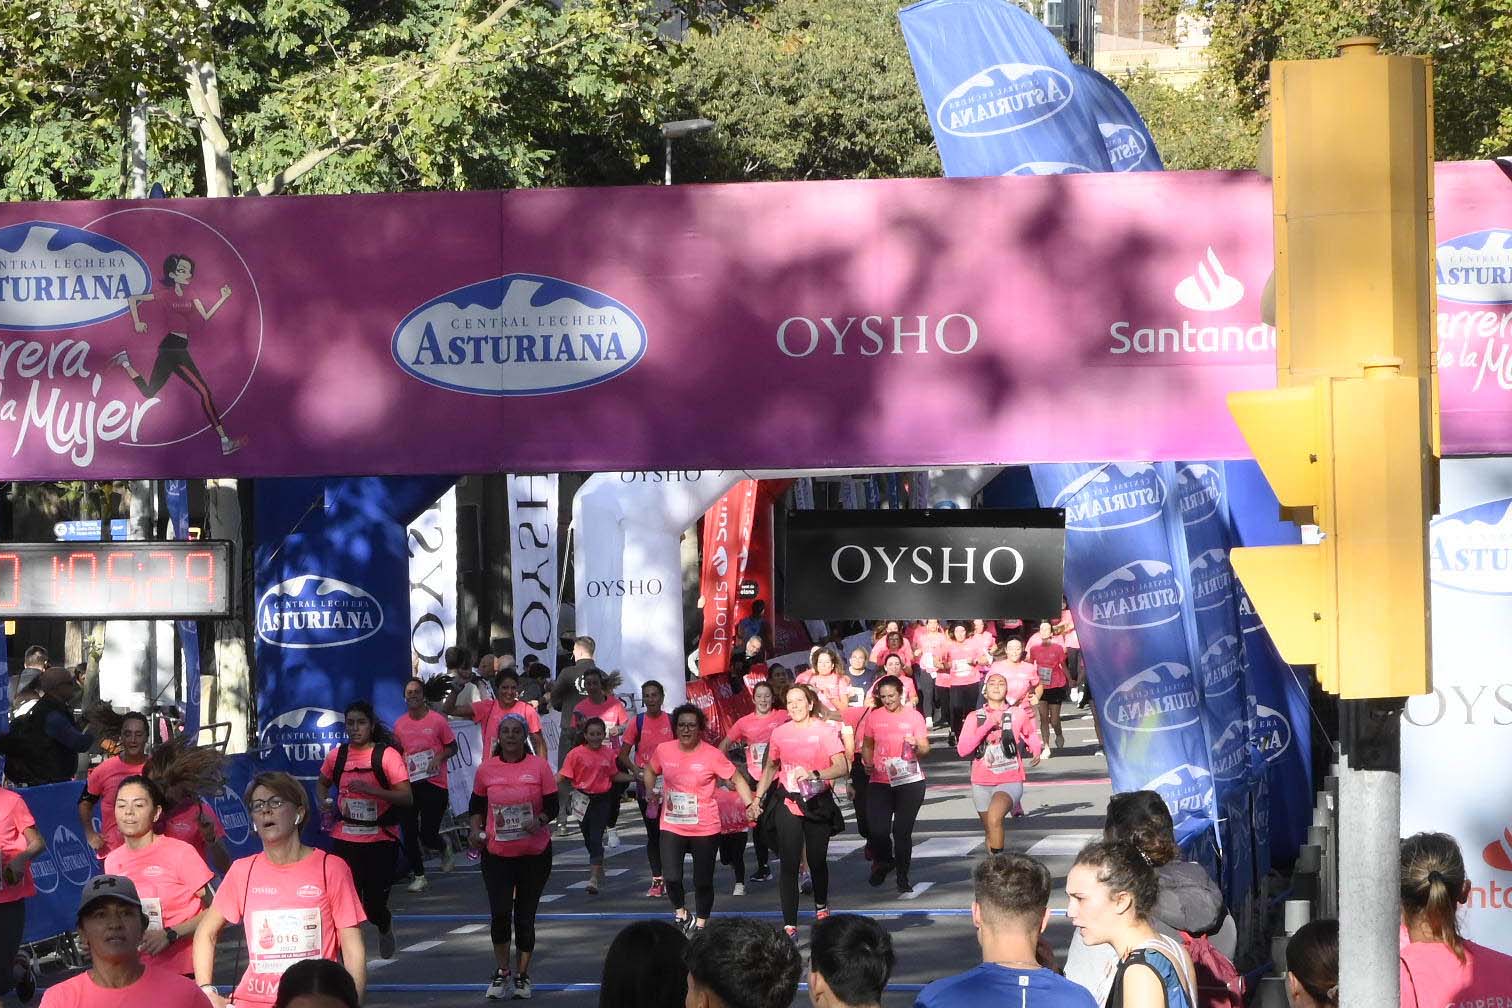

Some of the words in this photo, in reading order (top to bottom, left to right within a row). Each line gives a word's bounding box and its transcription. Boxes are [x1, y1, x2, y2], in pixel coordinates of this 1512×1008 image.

[55, 257, 126, 269] LECHERA
[451, 316, 529, 329] CENTRAL
[538, 314, 618, 327] LECHERA
[776, 313, 978, 358] OYSHO
[1110, 319, 1276, 354] Santand
[412, 322, 627, 366] ASTURIANA
[11, 375, 161, 468] Mujer
[408, 502, 446, 664] OYS
[831, 545, 1025, 586] OYSHO
[274, 600, 316, 608] CENTRAL
[321, 600, 370, 608] LECHERA
[586, 578, 663, 598] OYSHO
[261, 604, 375, 632] ASTURIANA
[707, 581, 728, 655] Sports
